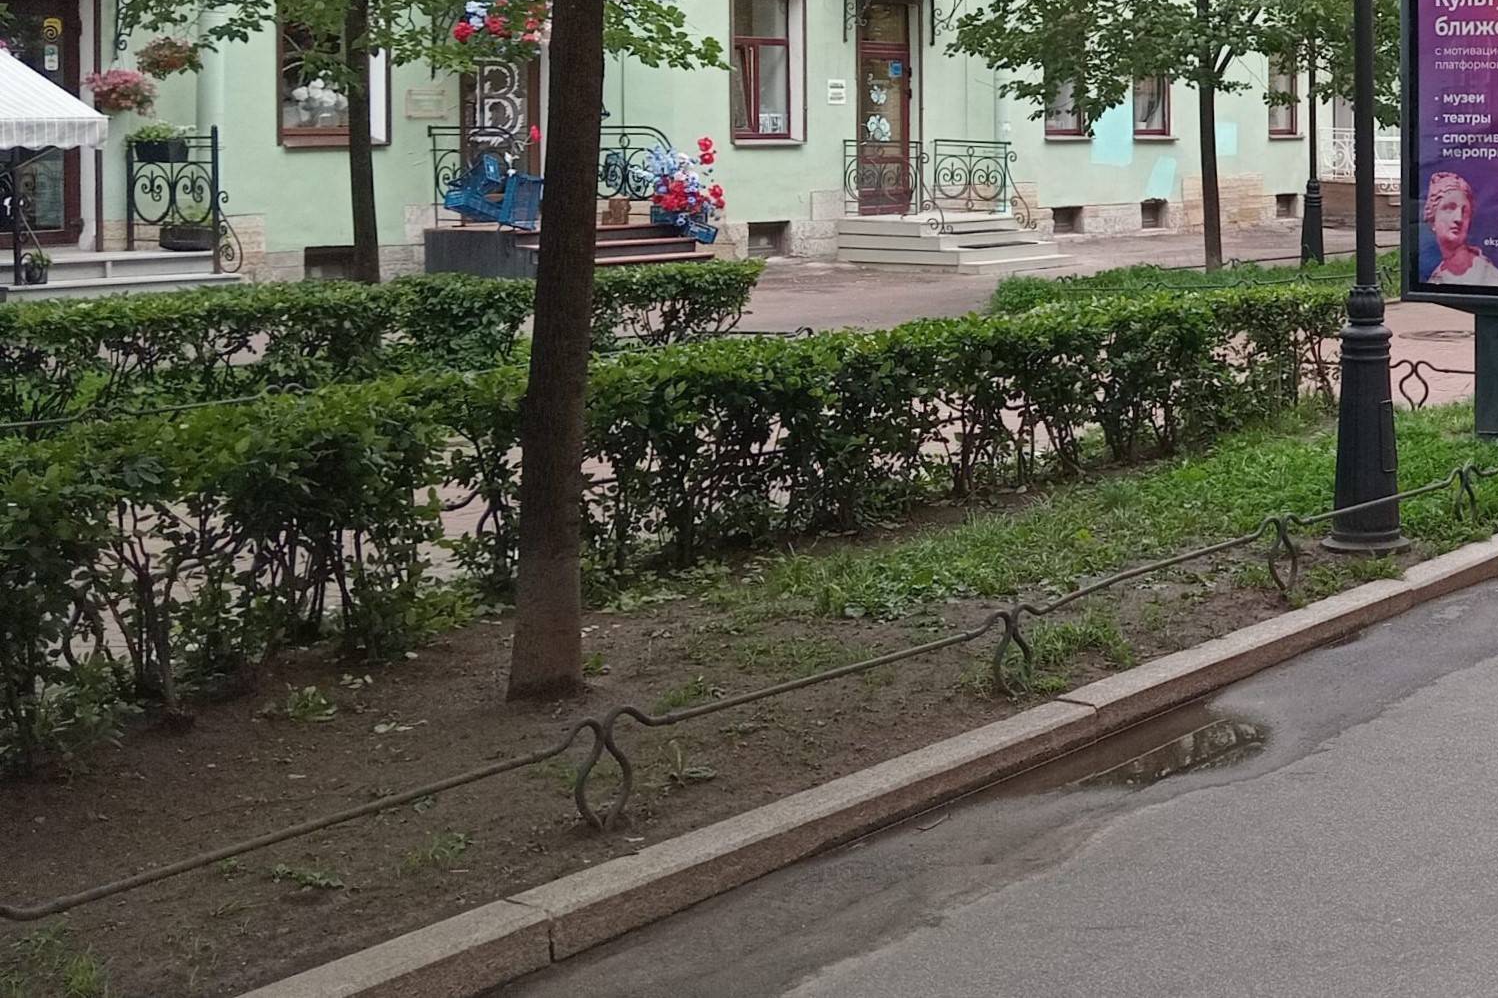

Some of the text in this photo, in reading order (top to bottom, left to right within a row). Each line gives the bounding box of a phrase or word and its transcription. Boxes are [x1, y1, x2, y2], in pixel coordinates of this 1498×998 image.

[1434, 47, 1442, 56] с
[1443, 93, 1485, 106] музеи
[1442, 113, 1492, 126] театры
